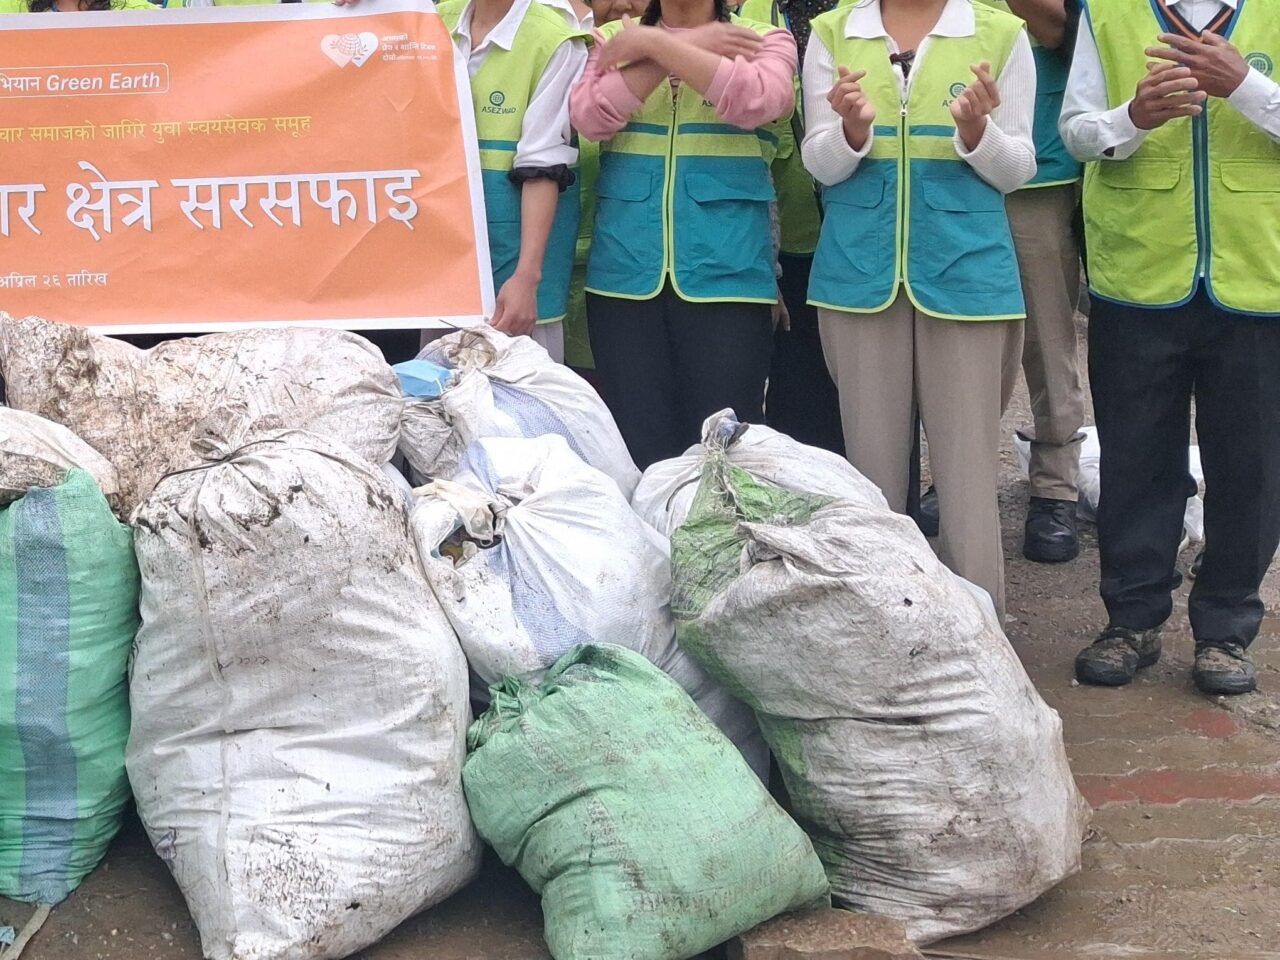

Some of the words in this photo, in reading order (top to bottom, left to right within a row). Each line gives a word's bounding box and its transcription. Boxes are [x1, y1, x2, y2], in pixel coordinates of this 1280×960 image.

[46, 73, 103, 92] Green
[109, 72, 161, 90] Earth
[29, 119, 96, 142] समाजको
[100, 118, 146, 140] जागिरे
[151, 121, 182, 144] युवा
[272, 115, 313, 139] समूह
[65, 160, 159, 241] क्षेत्र
[170, 168, 421, 231] सरसफाइ
[42, 273, 62, 288] २६
[65, 270, 108, 288] तारिख
